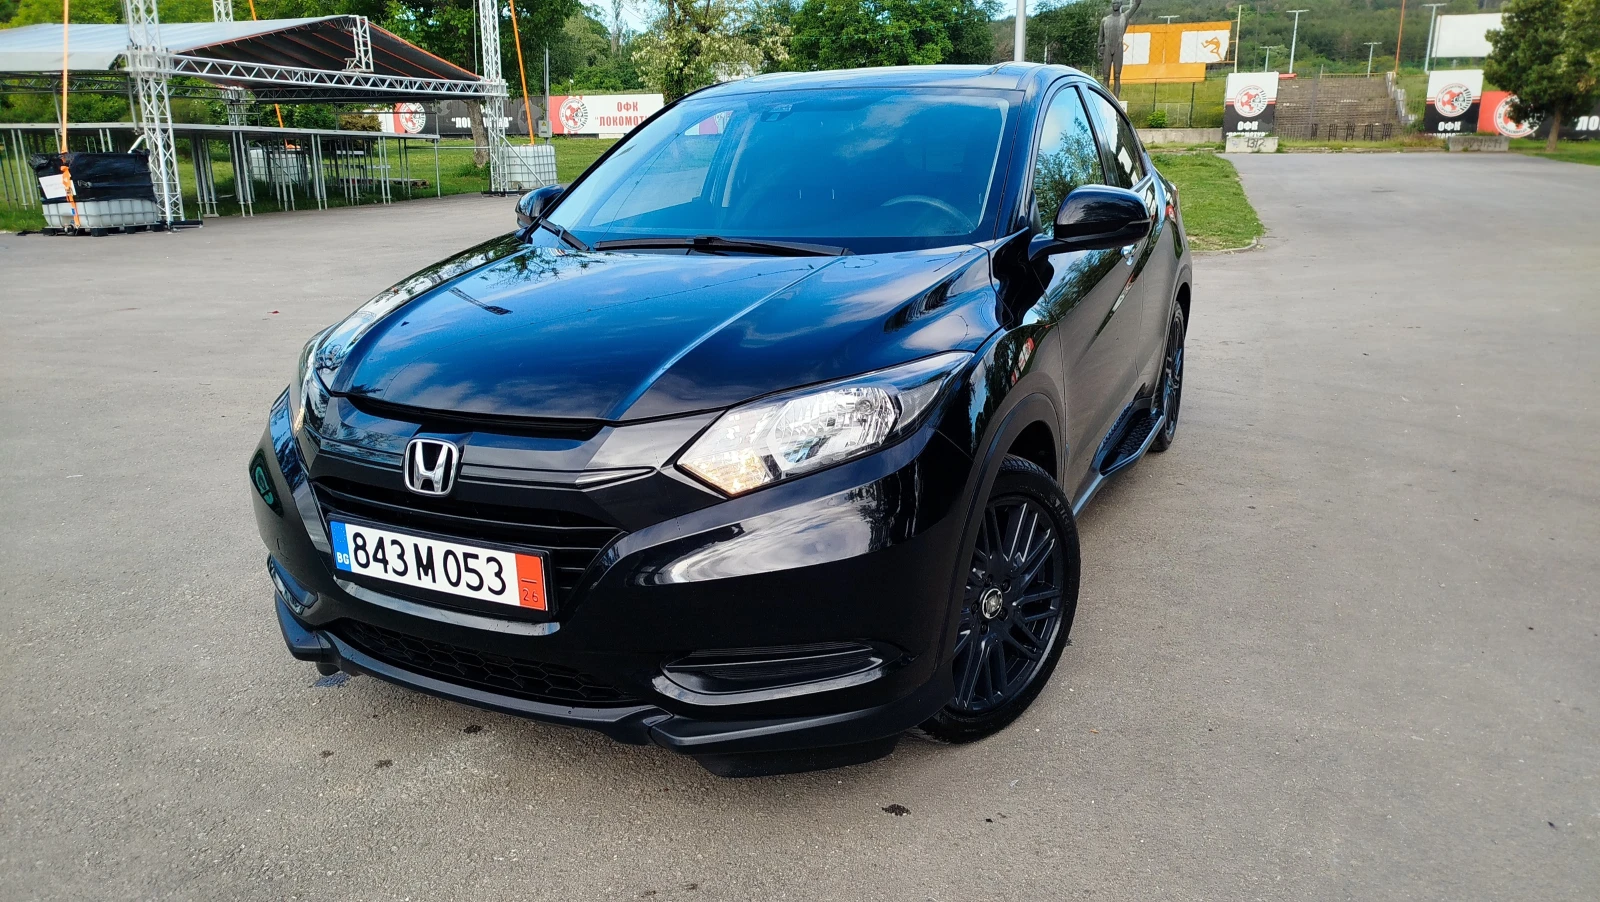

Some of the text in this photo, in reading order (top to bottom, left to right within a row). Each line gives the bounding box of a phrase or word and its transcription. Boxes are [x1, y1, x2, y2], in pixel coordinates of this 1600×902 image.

[617, 101, 638, 113] ОФК
[595, 115, 649, 127] "ЛОКОМОТ
[1438, 121, 1462, 131] ОФК
[336, 551, 350, 565] BG
[352, 531, 507, 596] 843 M 053
[522, 587, 539, 603] 26
